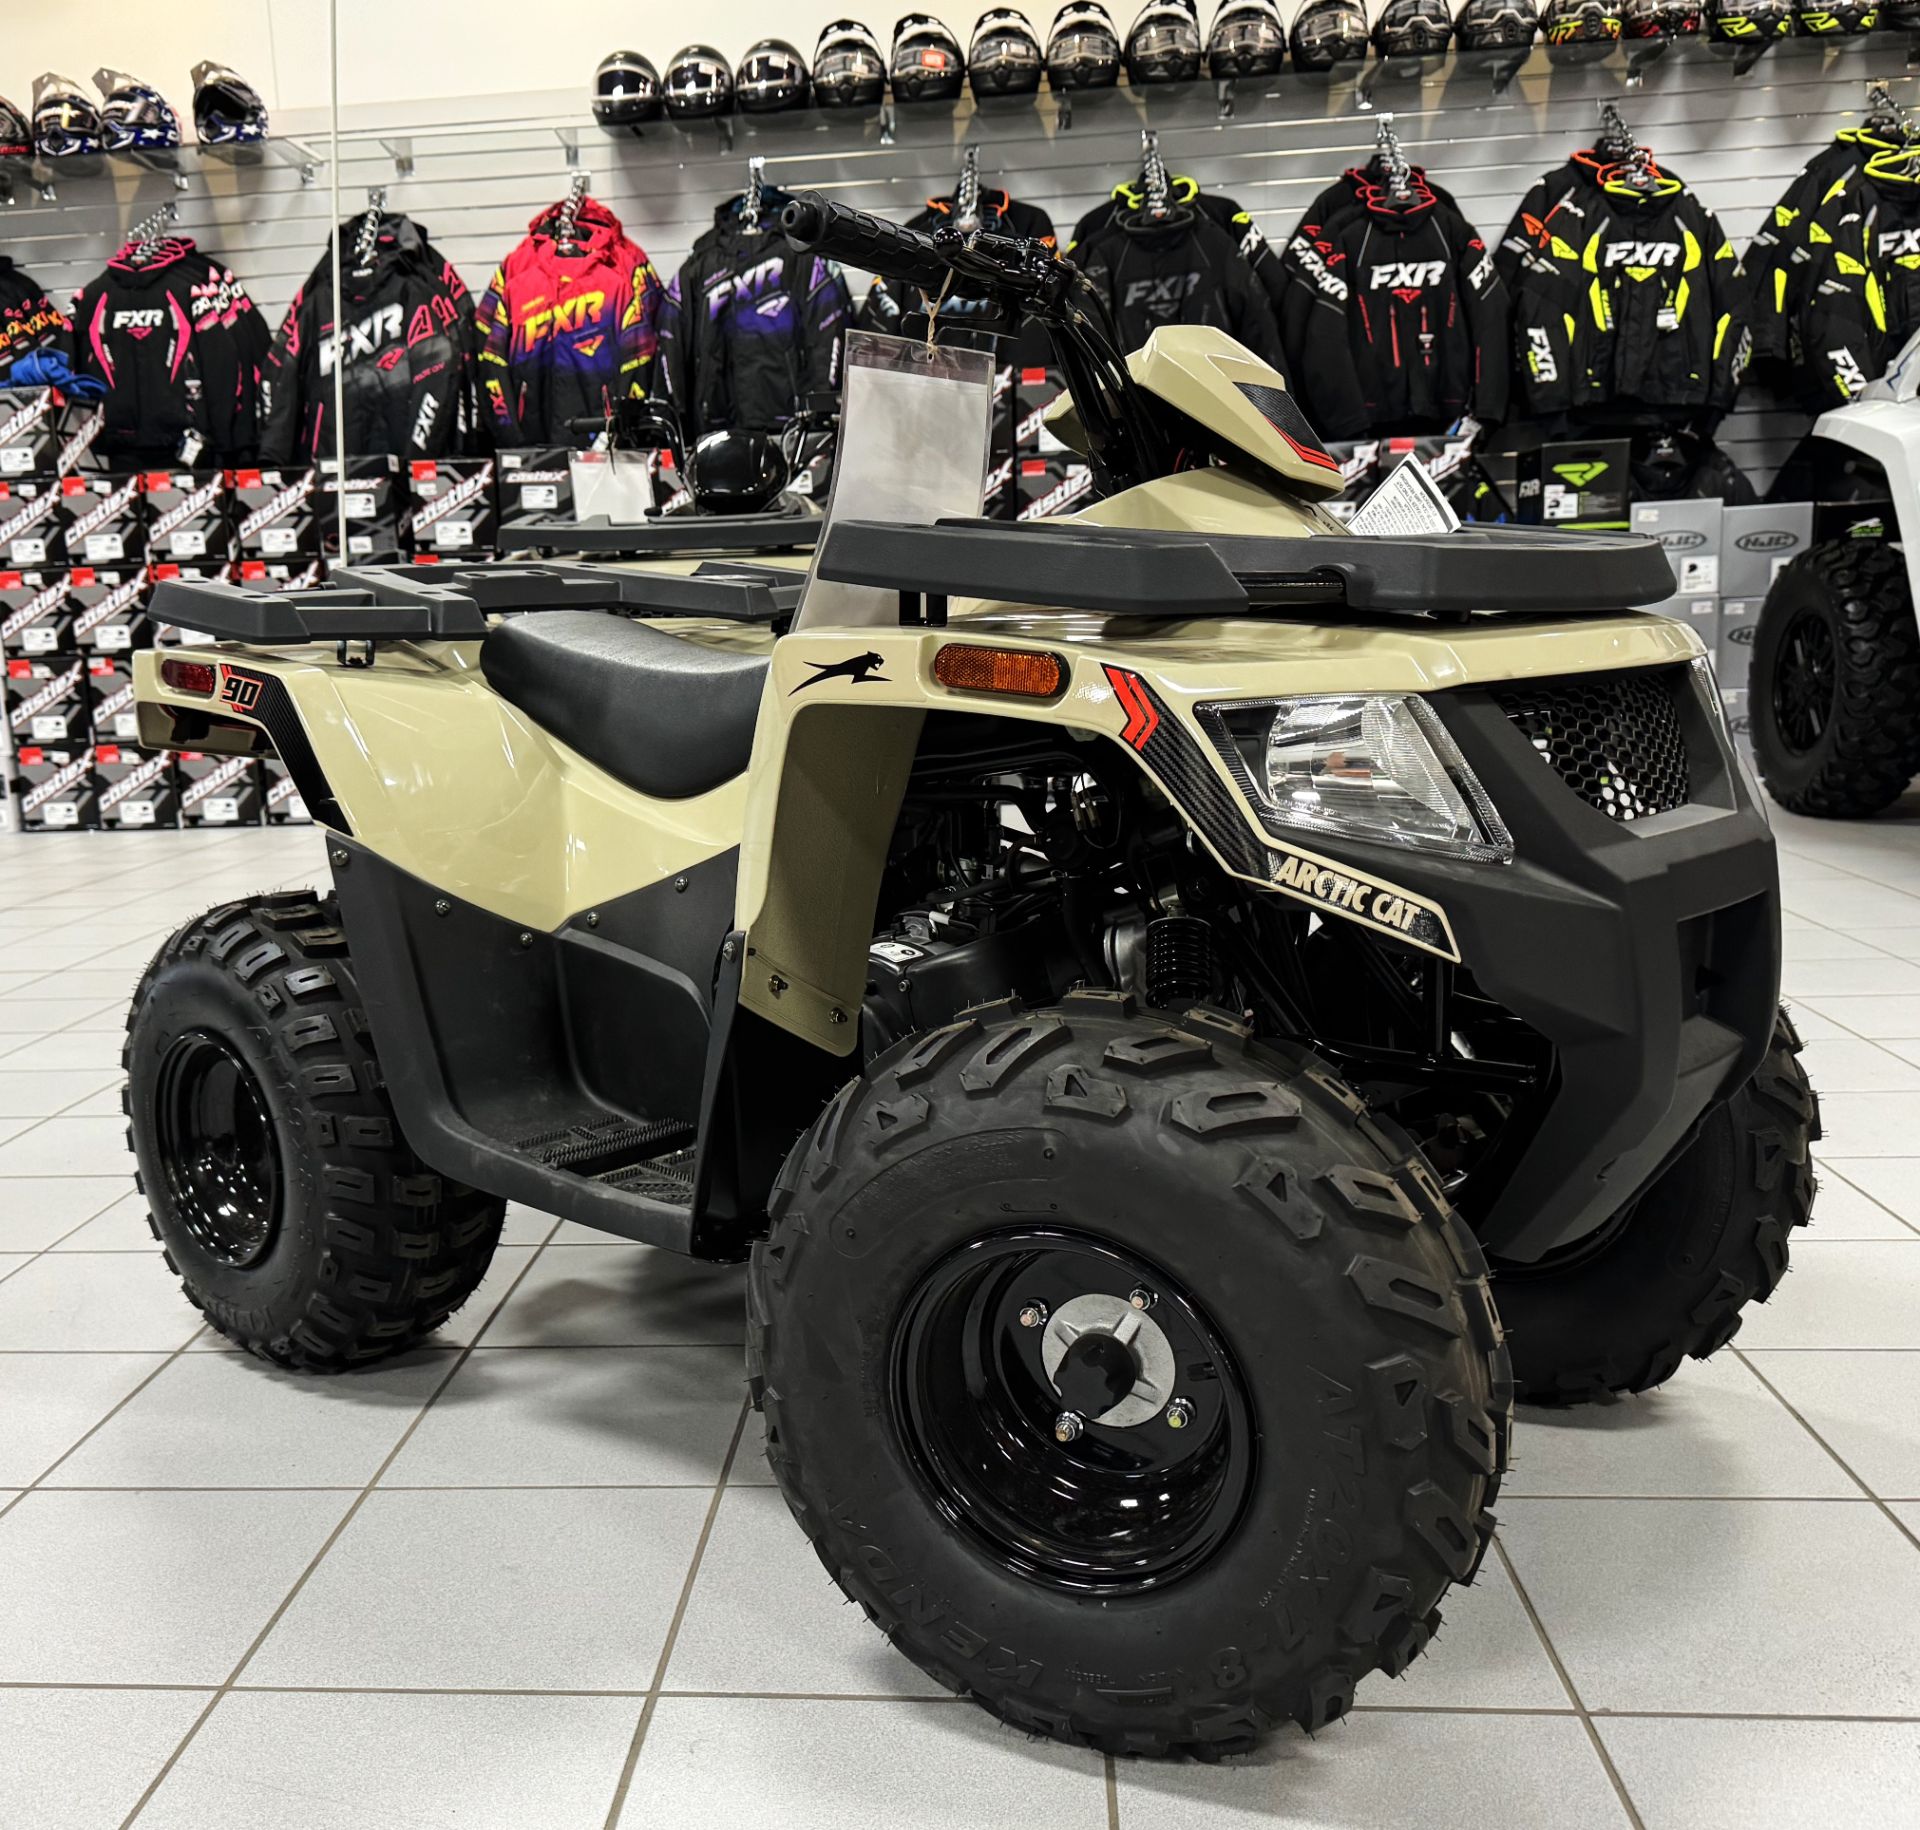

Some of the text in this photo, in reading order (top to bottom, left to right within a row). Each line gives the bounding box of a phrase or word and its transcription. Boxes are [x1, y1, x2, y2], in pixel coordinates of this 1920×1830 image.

[1604, 241, 1681, 267] FXR
[1879, 230, 1920, 257] FX
[706, 257, 784, 320] FXR
[1124, 273, 1200, 307] FXR
[1370, 260, 1447, 290] FXR
[113, 309, 164, 329] FXR
[318, 302, 404, 377] FXR
[524, 291, 605, 352] FXR
[1527, 326, 1558, 383] FXR
[0, 387, 51, 446] stleX
[412, 392, 440, 450] FXR
[0, 480, 60, 546] astleX
[1016, 467, 1093, 521] castle
[92, 682, 134, 725] cast
[222, 676, 260, 706] 90
[1275, 857, 1421, 931] ARCTIC CAT
